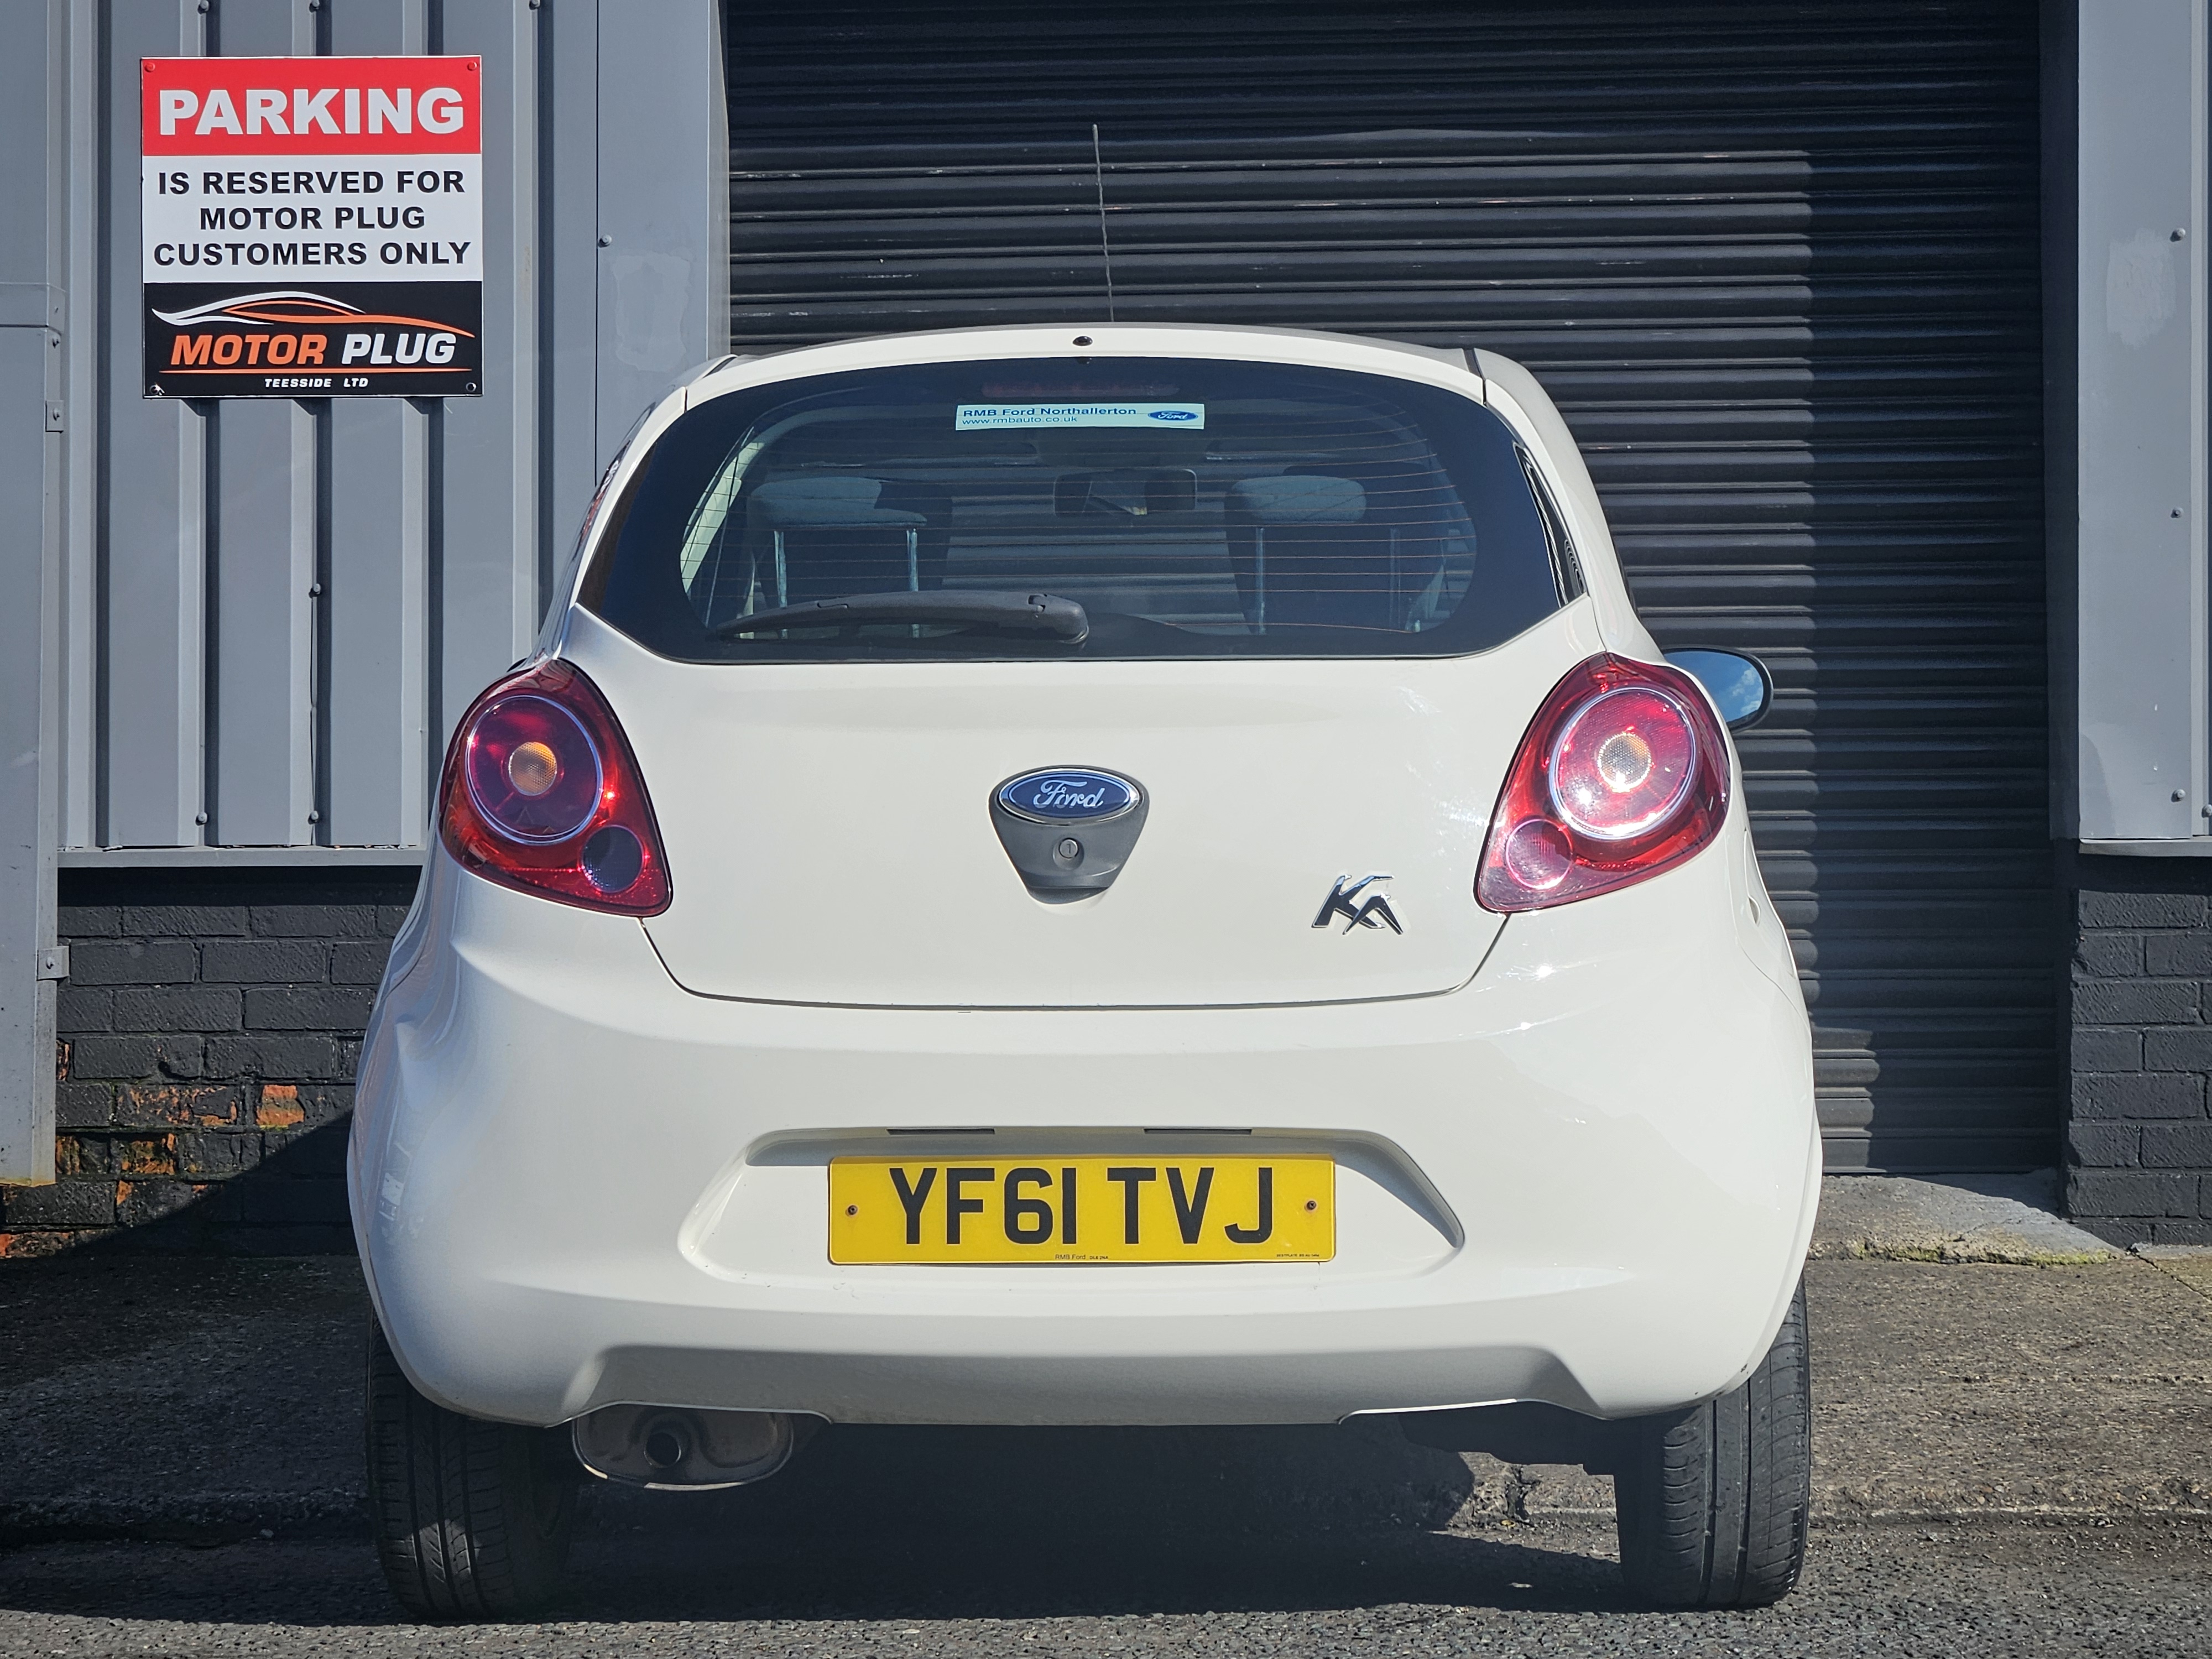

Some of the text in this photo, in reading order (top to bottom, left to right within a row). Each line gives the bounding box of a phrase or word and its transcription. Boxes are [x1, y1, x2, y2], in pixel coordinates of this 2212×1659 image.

[159, 87, 464, 135] PARKING
[159, 170, 465, 195] IS RESERVED FOR
[200, 206, 425, 230] MOTOR PLUG
[154, 242, 471, 266] CUSTOMERS ONLY
[170, 333, 457, 366] MOTOR PLUG
[264, 378, 369, 388] TEESSIDE LTD
[962, 416, 1078, 425] www.rmbauto.co.uk
[1040, 408, 1136, 416] Northallerton
[1157, 411, 1189, 420] Ford
[1033, 779, 1105, 808] Ford
[889, 1167, 1273, 1245] YF61 TVJ
